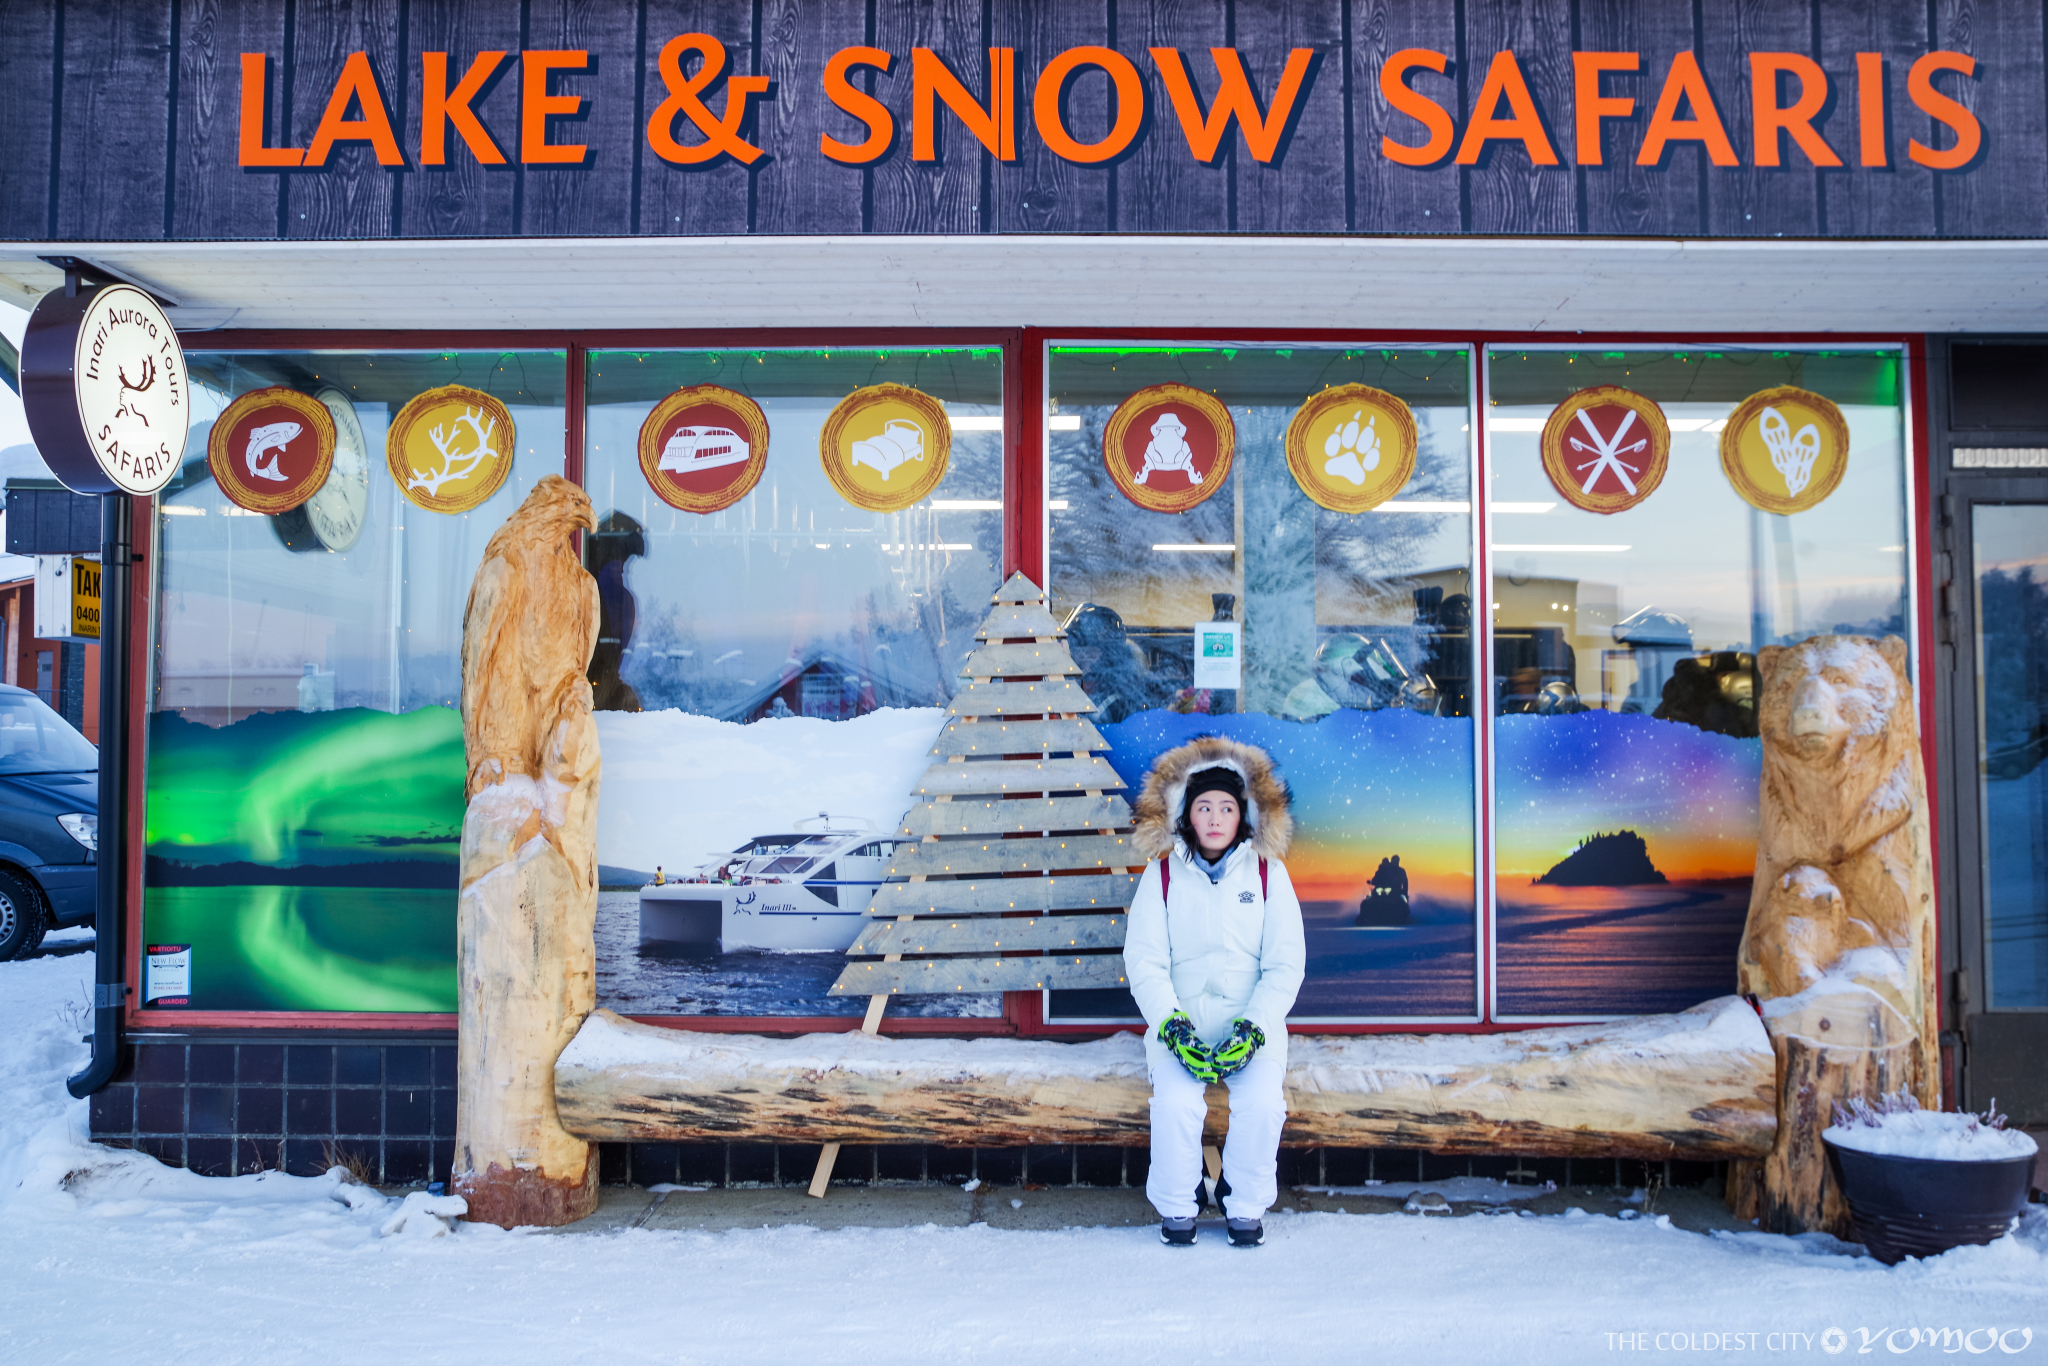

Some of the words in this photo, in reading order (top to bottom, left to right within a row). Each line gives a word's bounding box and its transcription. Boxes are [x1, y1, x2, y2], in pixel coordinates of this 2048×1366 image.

[239, 50, 588, 166] LAKE
[647, 32, 770, 165] &
[820, 45, 1314, 163] SNOW
[1380, 48, 1981, 169] SAFARIS
[86, 321, 109, 381] Inari
[108, 306, 159, 341] Aurora
[160, 336, 180, 406] Tours
[98, 424, 172, 480] SAFARIS
[74, 563, 101, 598] TAK
[76, 605, 99, 623] 0400
[78, 624, 97, 634] INARIN
[761, 903, 780, 911] Inari
[782, 903, 792, 911] III
